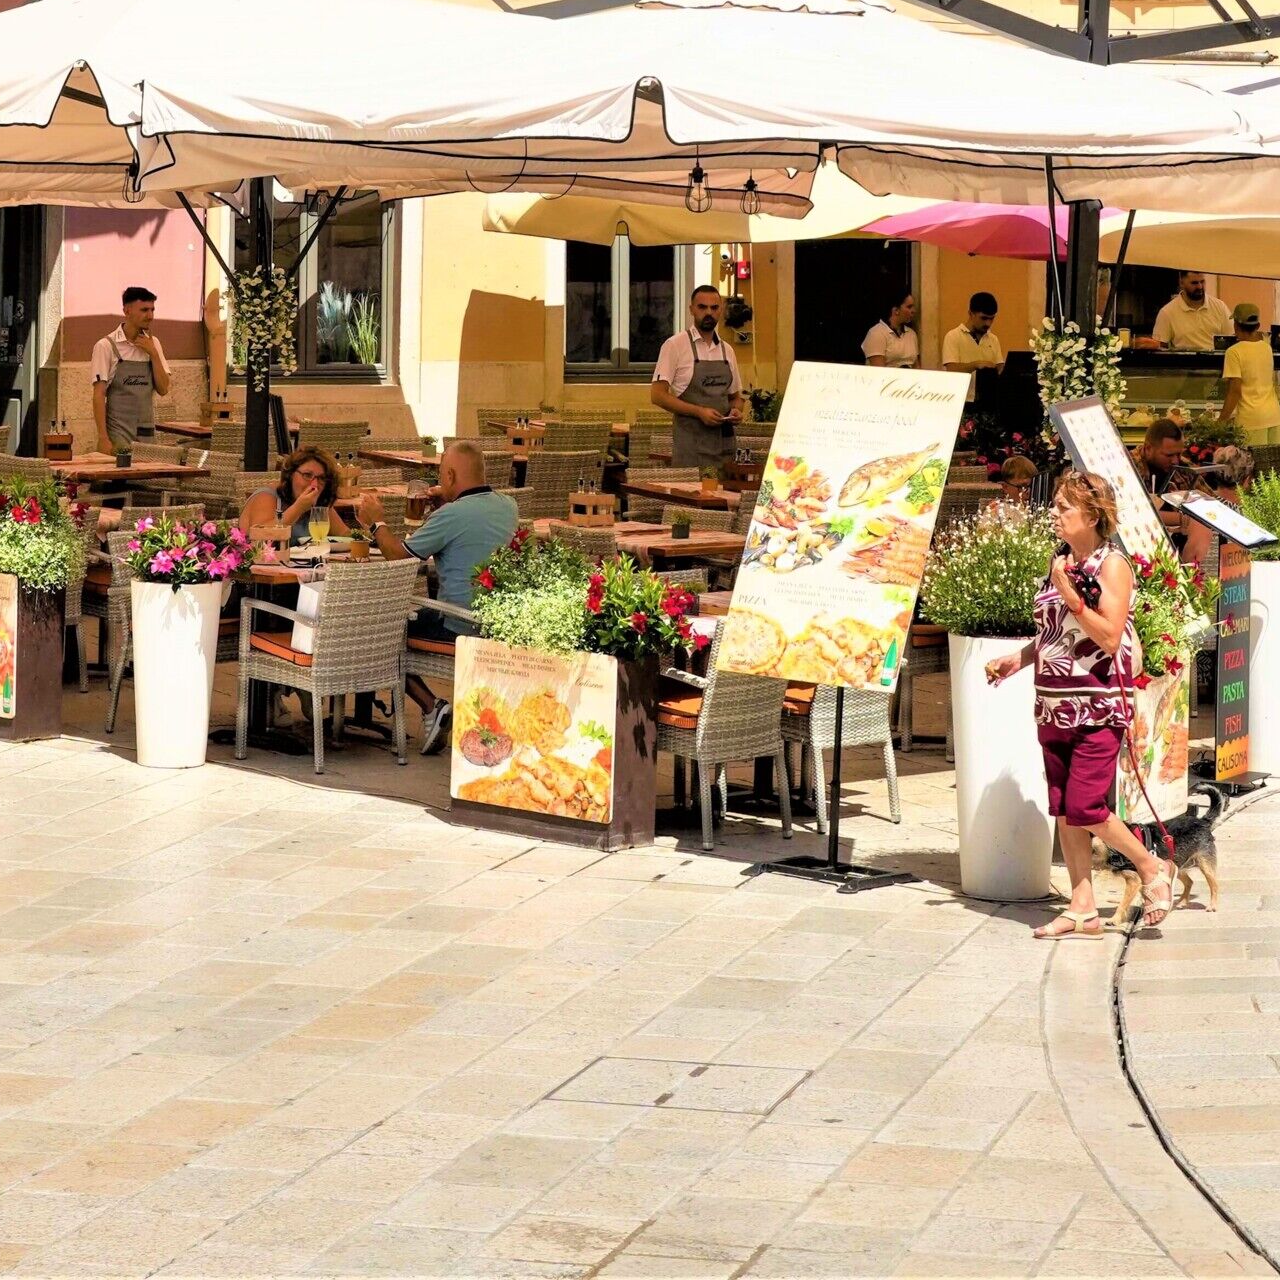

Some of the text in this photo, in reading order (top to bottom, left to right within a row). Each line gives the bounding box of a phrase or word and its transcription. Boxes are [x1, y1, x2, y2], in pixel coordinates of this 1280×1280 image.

[738, 593, 768, 607] PIZZA
[1224, 583, 1248, 606] STEAK
[1224, 648, 1246, 670] PIZZA
[1222, 680, 1245, 704] PASTA
[1224, 713, 1242, 736] FISH
[1217, 750, 1248, 773] CALISONA
